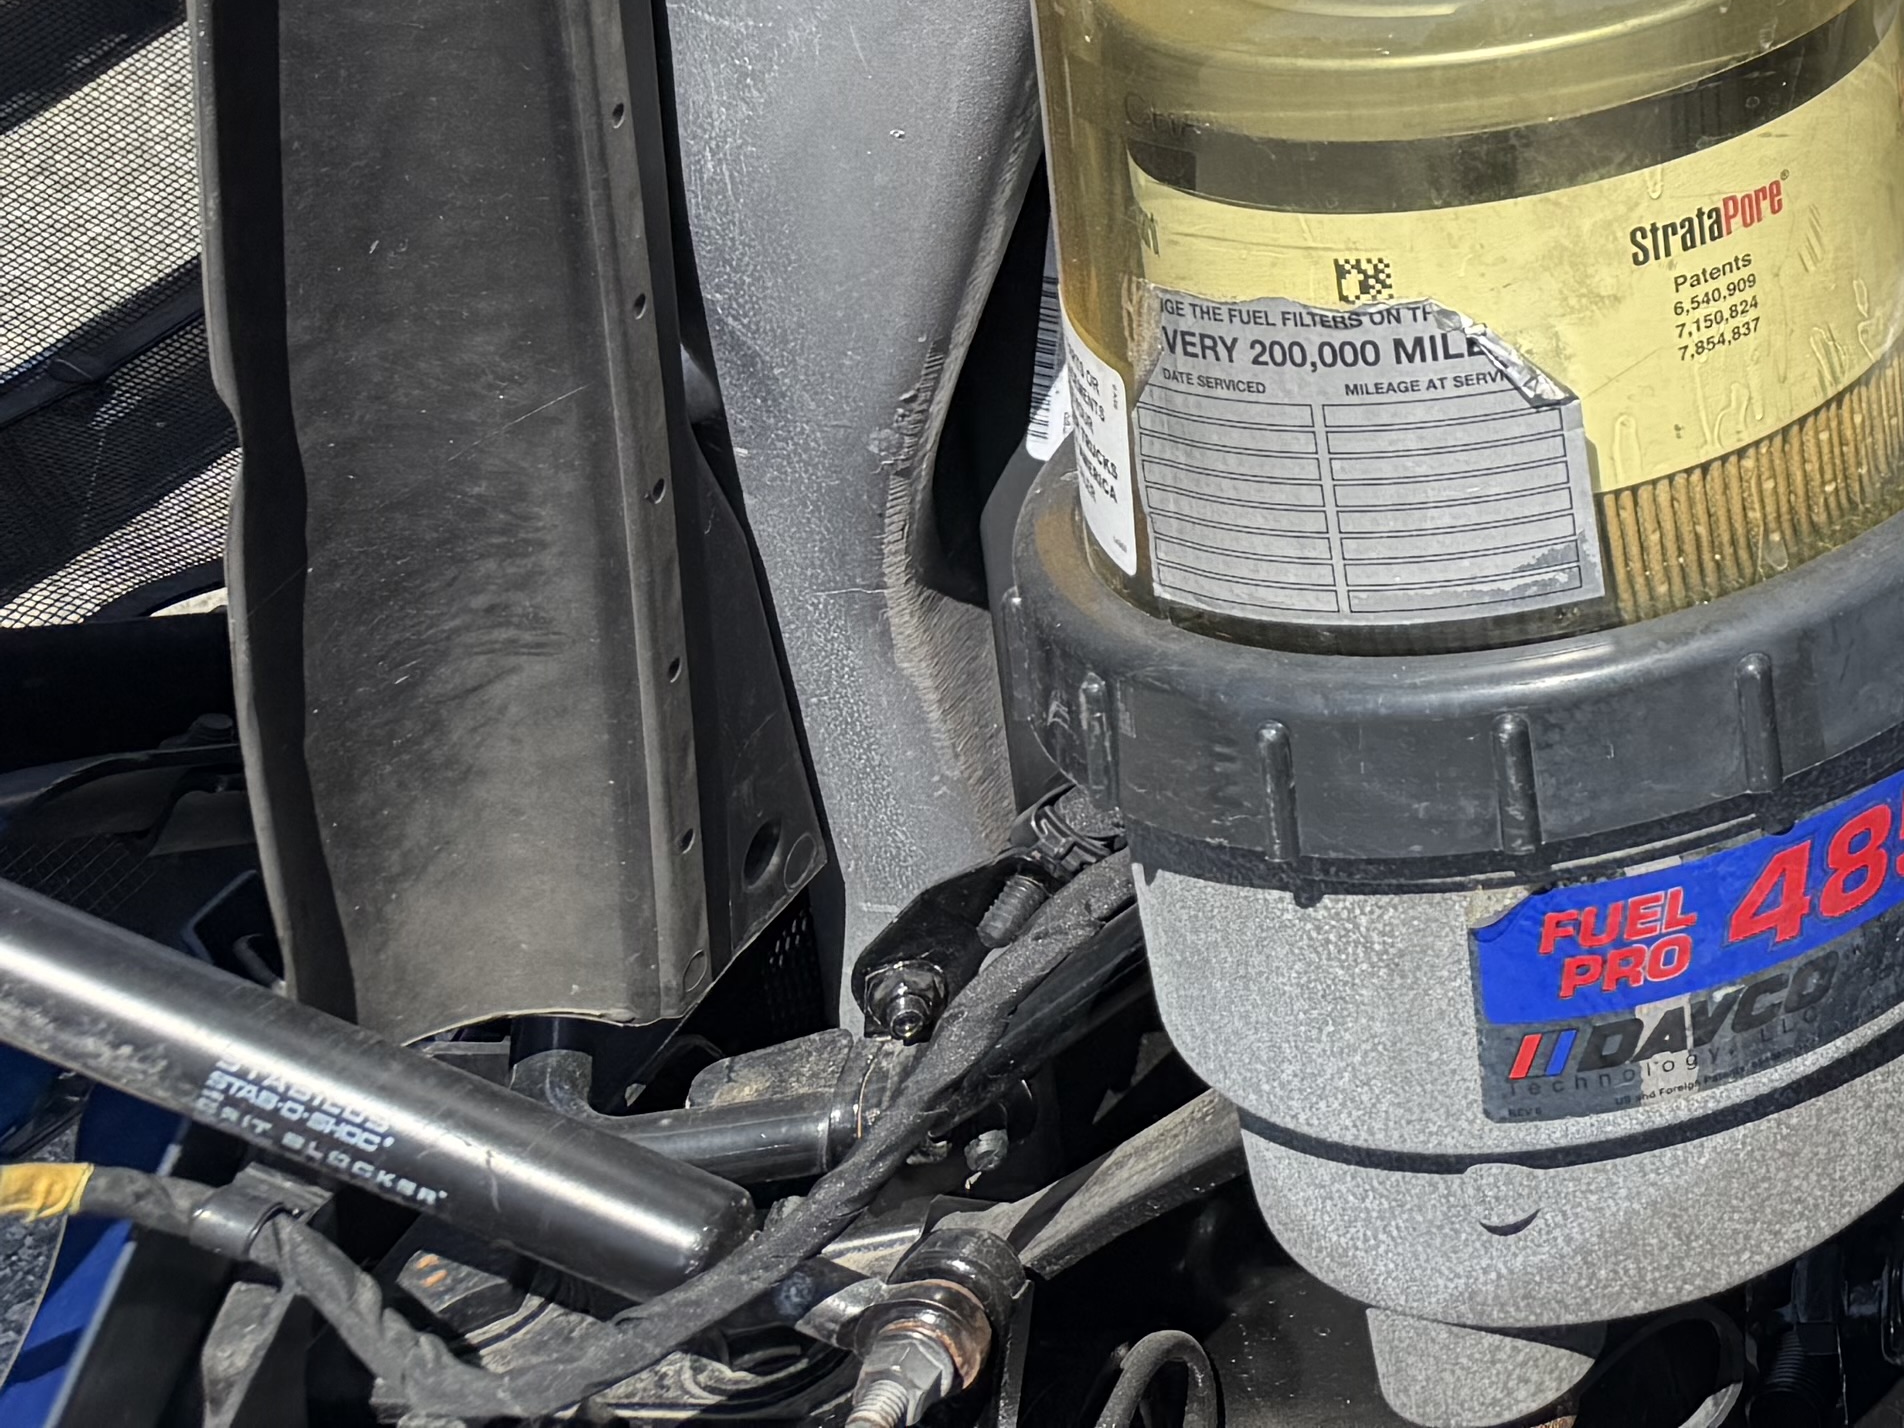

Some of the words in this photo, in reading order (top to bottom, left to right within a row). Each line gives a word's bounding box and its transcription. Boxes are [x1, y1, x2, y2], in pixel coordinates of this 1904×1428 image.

[1673, 253, 1752, 293] Patents
[1673, 274, 1756, 316] 6,540,909
[1189, 302, 1222, 322] THE
[1228, 308, 1276, 326] FUEL
[1282, 311, 1363, 329] FILTERS
[1675, 296, 1759, 339] 7,150,824
[1162, 326, 1238, 364] VERY
[1250, 339, 1381, 373] 200,000
[1678, 317, 1761, 362] 7,854,837
[1162, 368, 1195, 386] DATE
[1197, 375, 1266, 394] SERVICED
[1344, 380, 1421, 396] MILEAGE
[1426, 378, 1448, 391] AT
[1538, 886, 1698, 955] FUEL
[1559, 934, 1692, 999] PRO
[282, 1131, 437, 1204] BLOCKER
